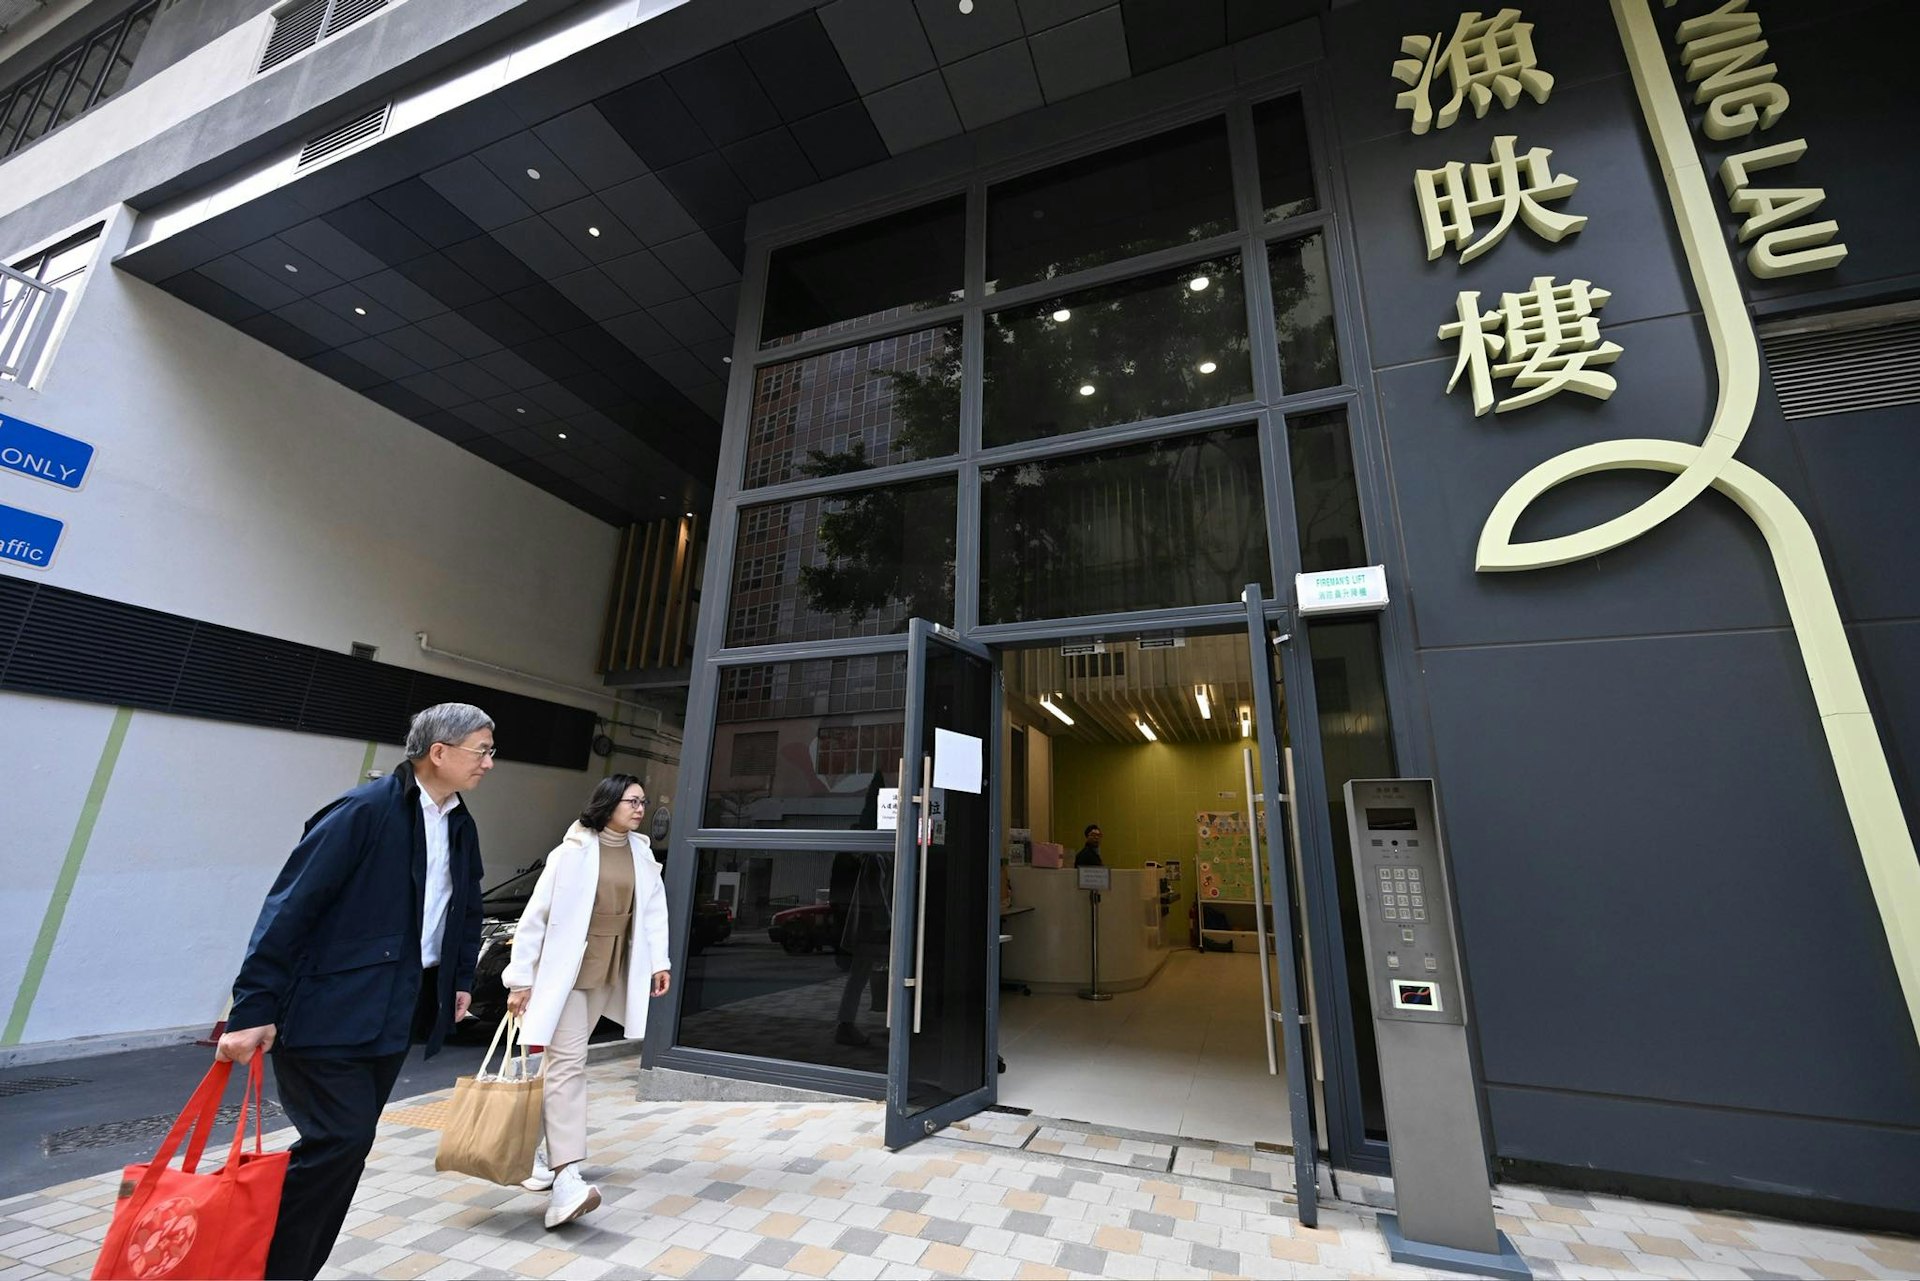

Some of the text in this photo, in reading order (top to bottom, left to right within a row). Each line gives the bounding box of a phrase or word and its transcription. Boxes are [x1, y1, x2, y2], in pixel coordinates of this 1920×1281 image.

[1392, 8, 1624, 417] 漁映樓
[1675, 0, 1848, 279] YING LAU
[1, 447, 76, 481] ONLY
[1316, 574, 1365, 587] FIREMAN'S LIFT
